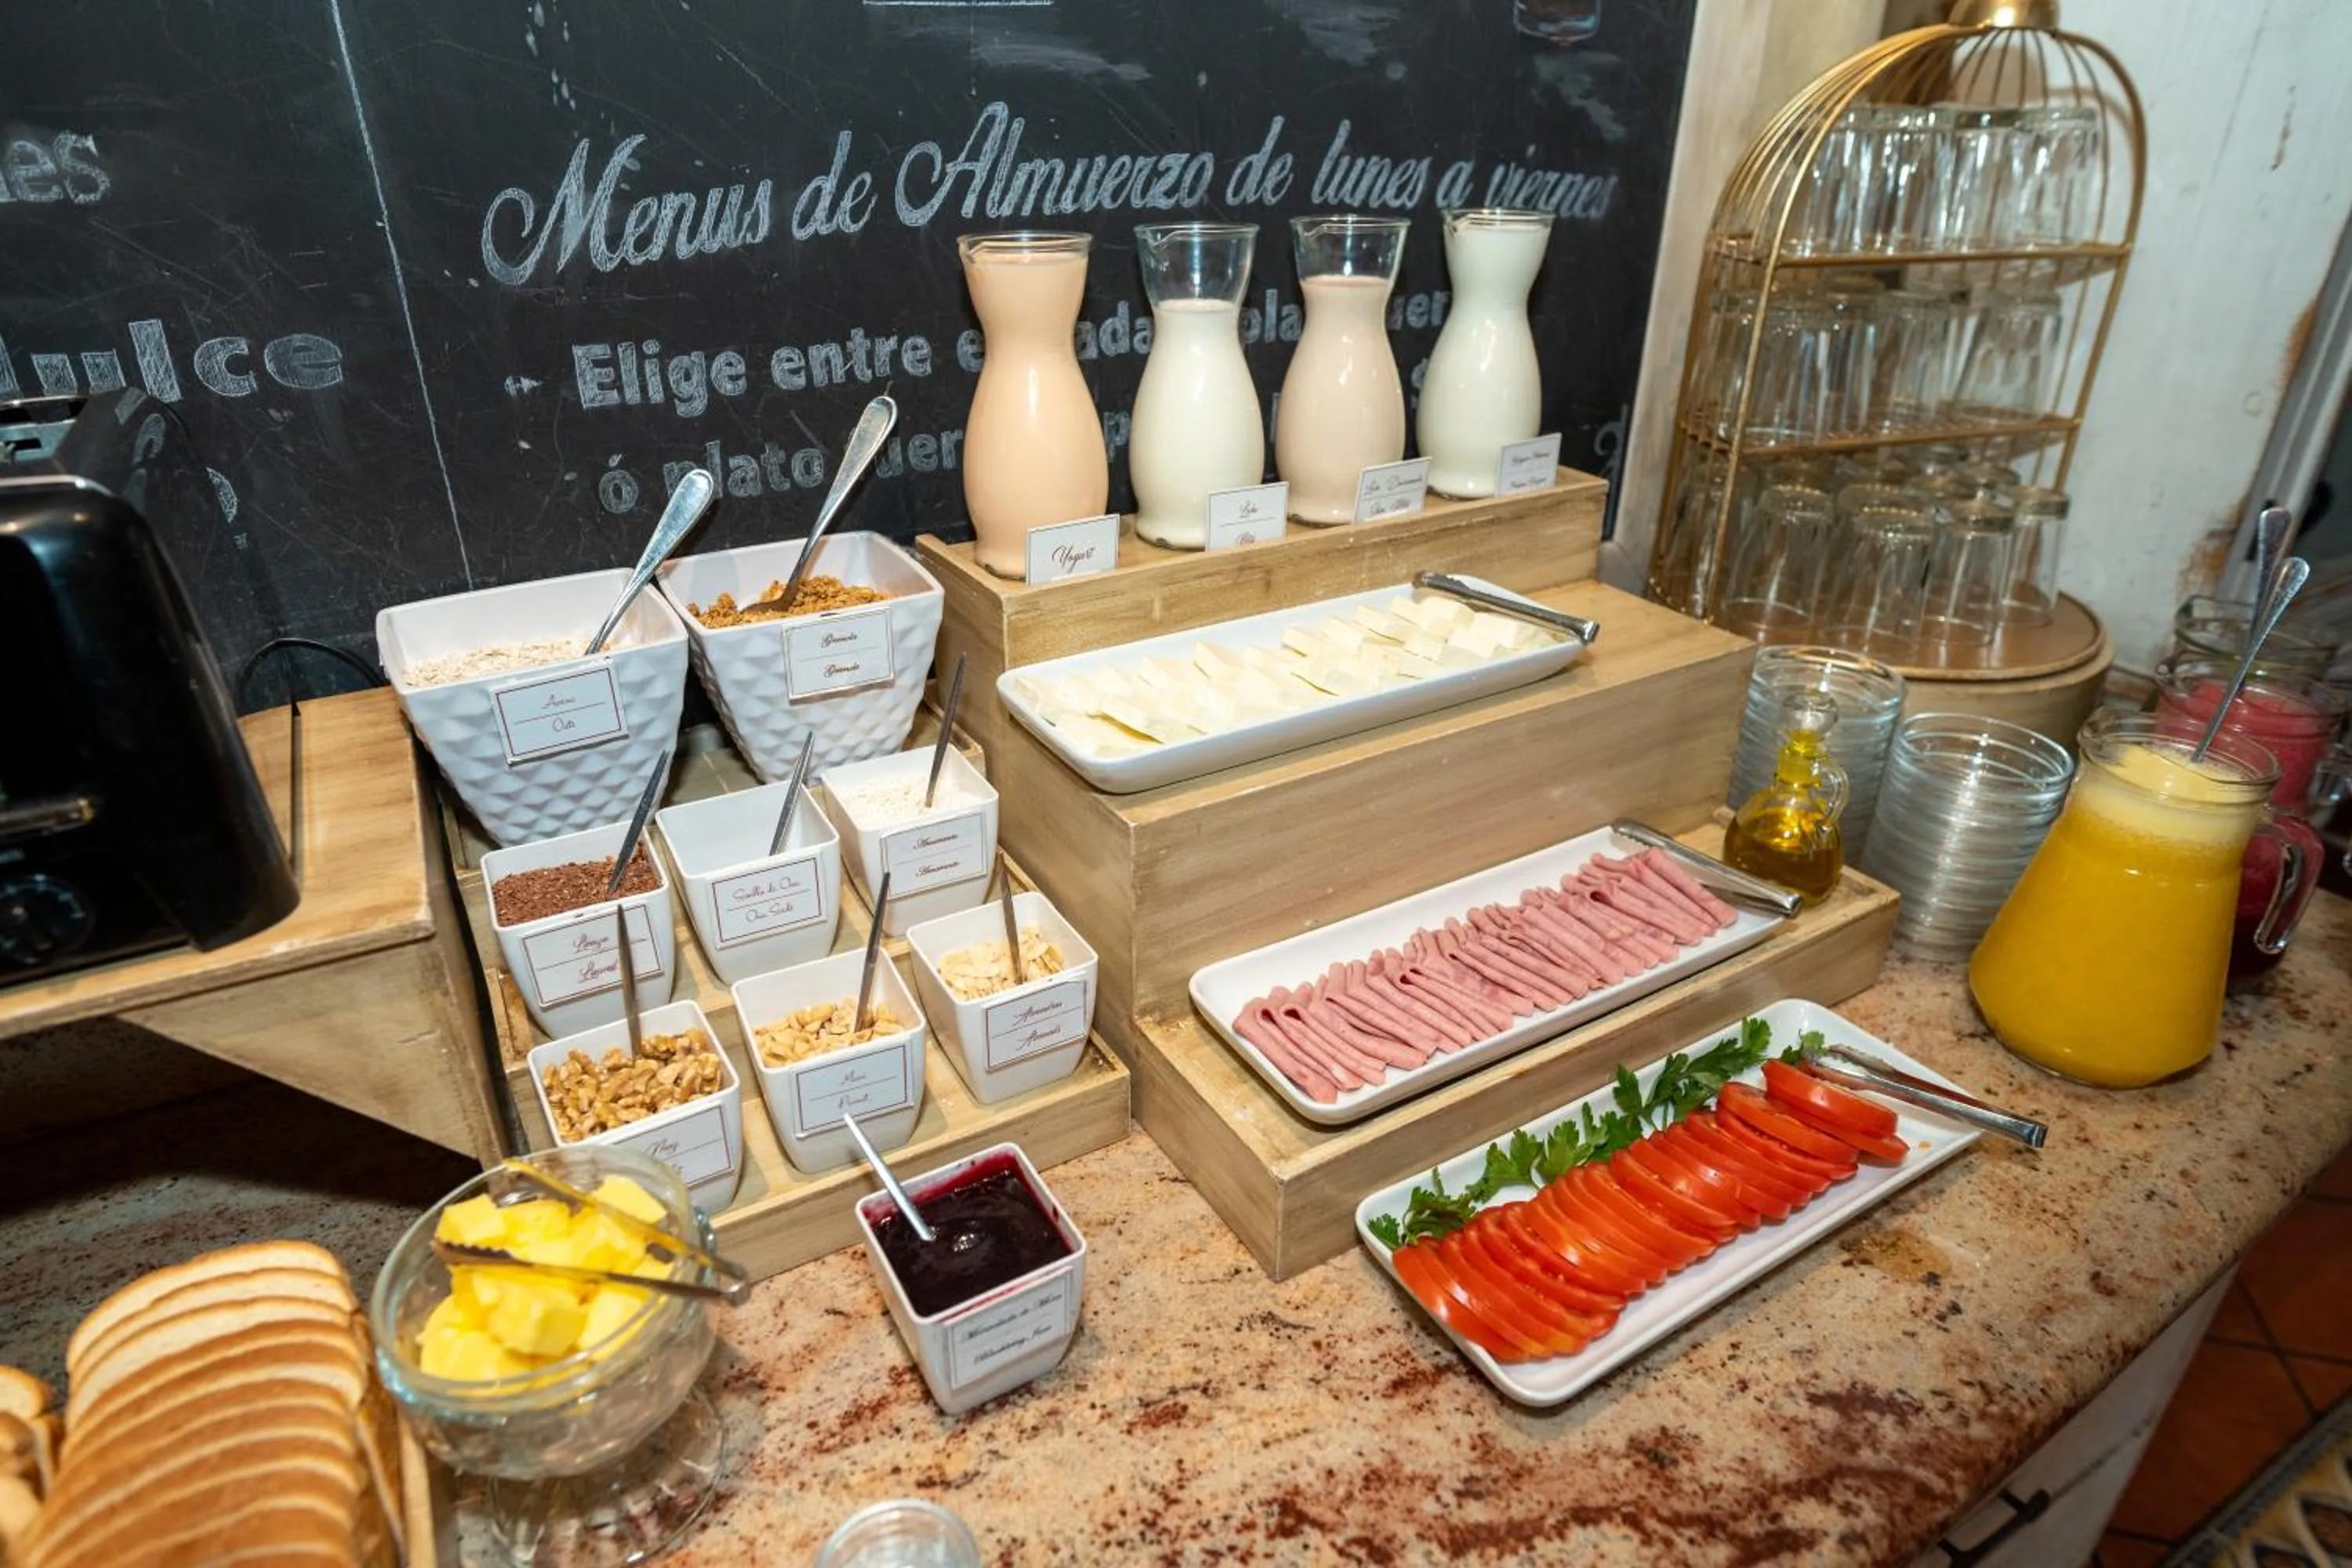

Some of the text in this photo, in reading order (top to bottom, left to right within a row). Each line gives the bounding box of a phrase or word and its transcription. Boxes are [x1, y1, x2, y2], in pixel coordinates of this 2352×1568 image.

[0, 129, 111, 204] es
[481, 100, 1620, 285] Menus de Almuerzo de lunes a viernes
[0, 318, 343, 403] ulce
[572, 341, 747, 418] Elige
[771, 327, 932, 390] entre
